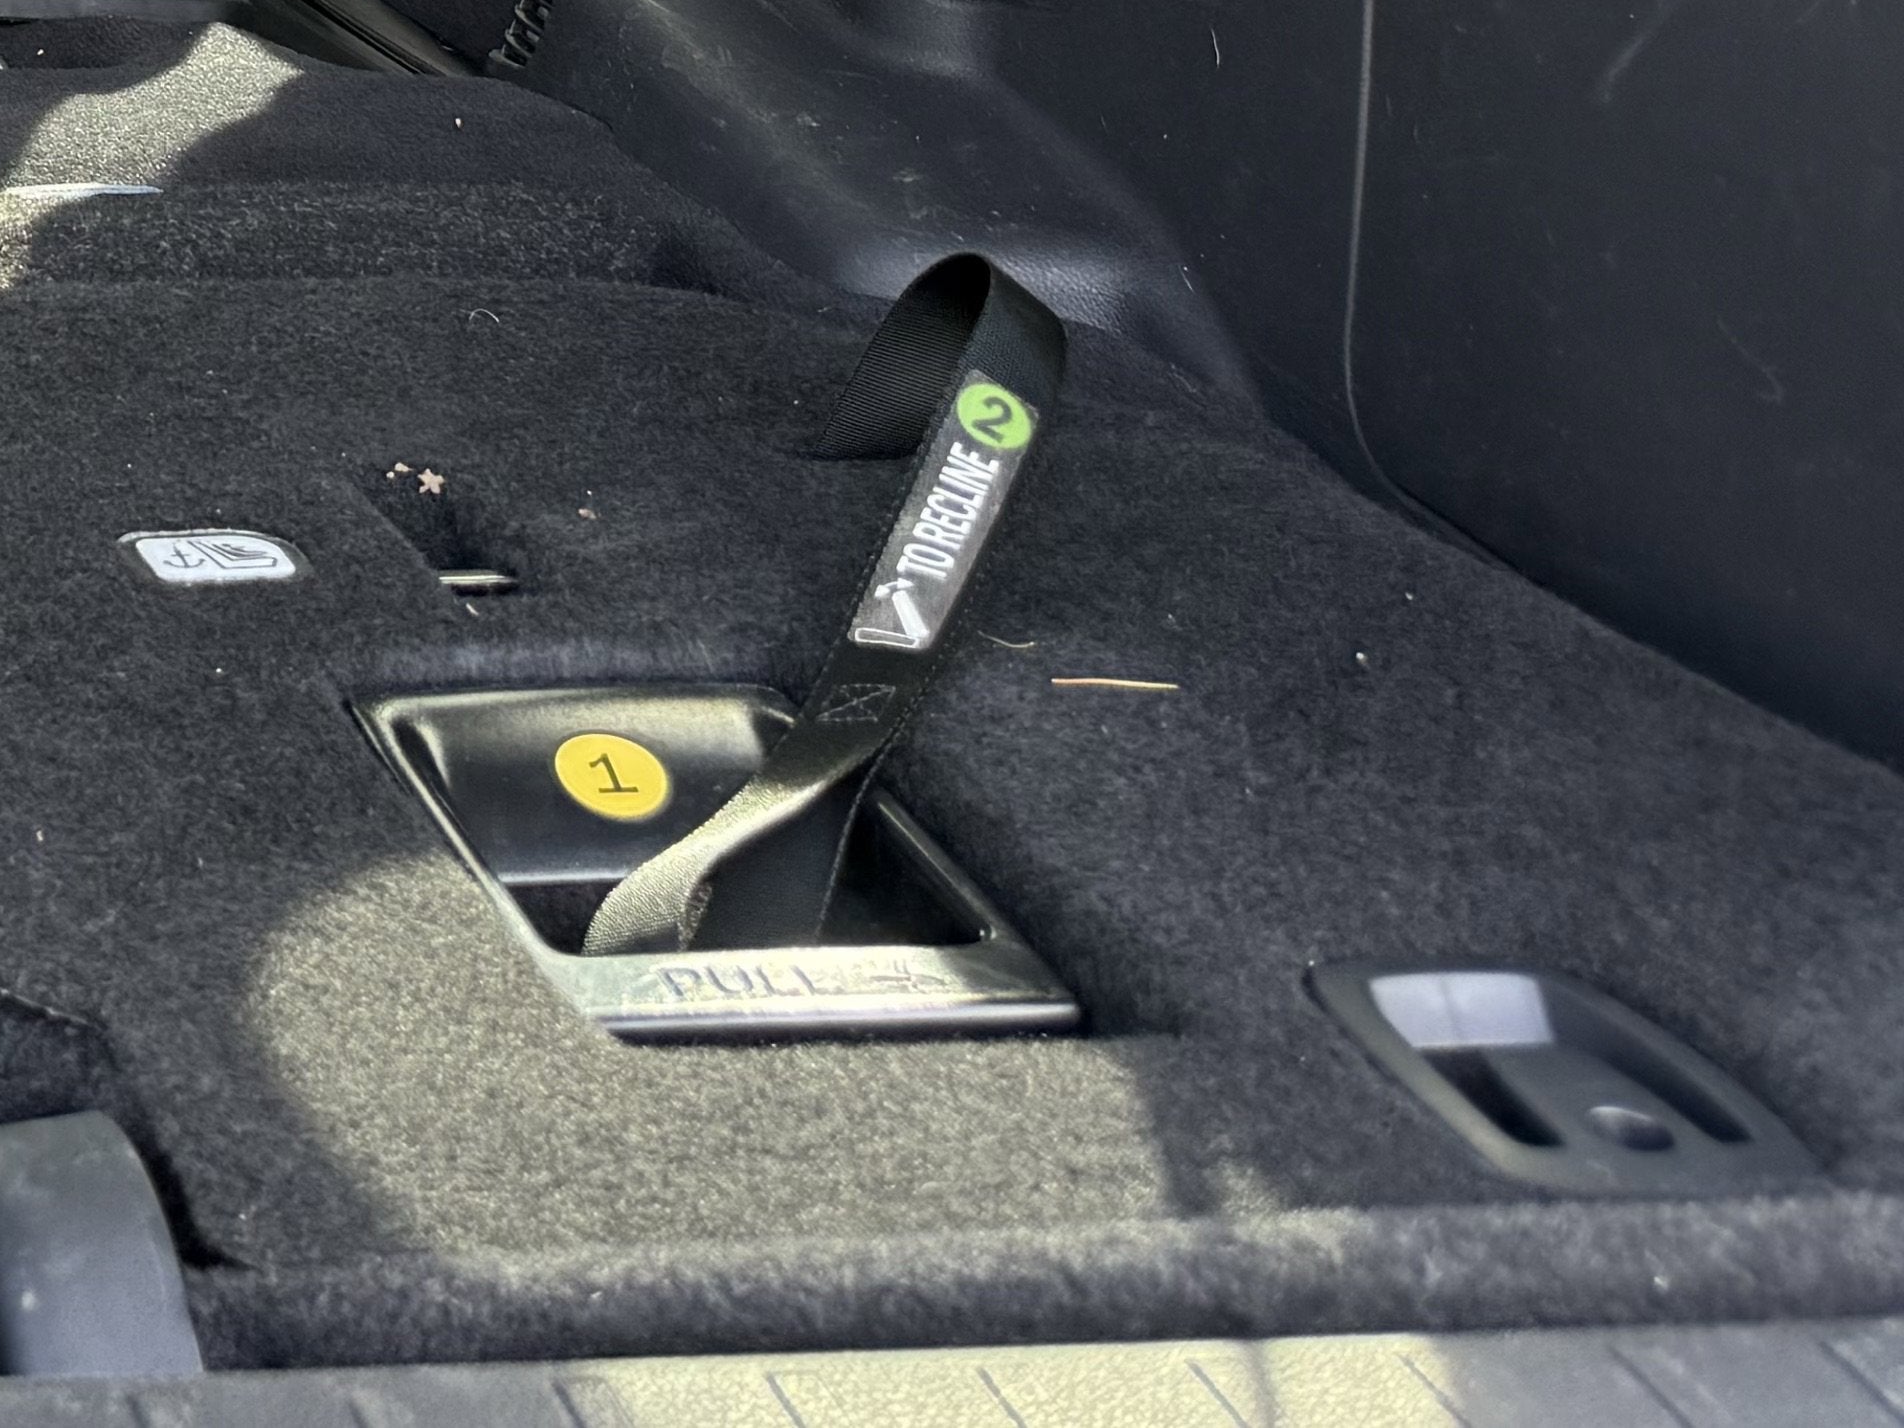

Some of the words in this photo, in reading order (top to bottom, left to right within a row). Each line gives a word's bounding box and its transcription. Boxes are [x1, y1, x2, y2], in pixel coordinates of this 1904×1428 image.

[972, 396, 1013, 443] 2
[912, 441, 1000, 551] RECLINE
[896, 543, 955, 579] TO
[586, 753, 639, 795] 1
[654, 963, 834, 999] PULL
